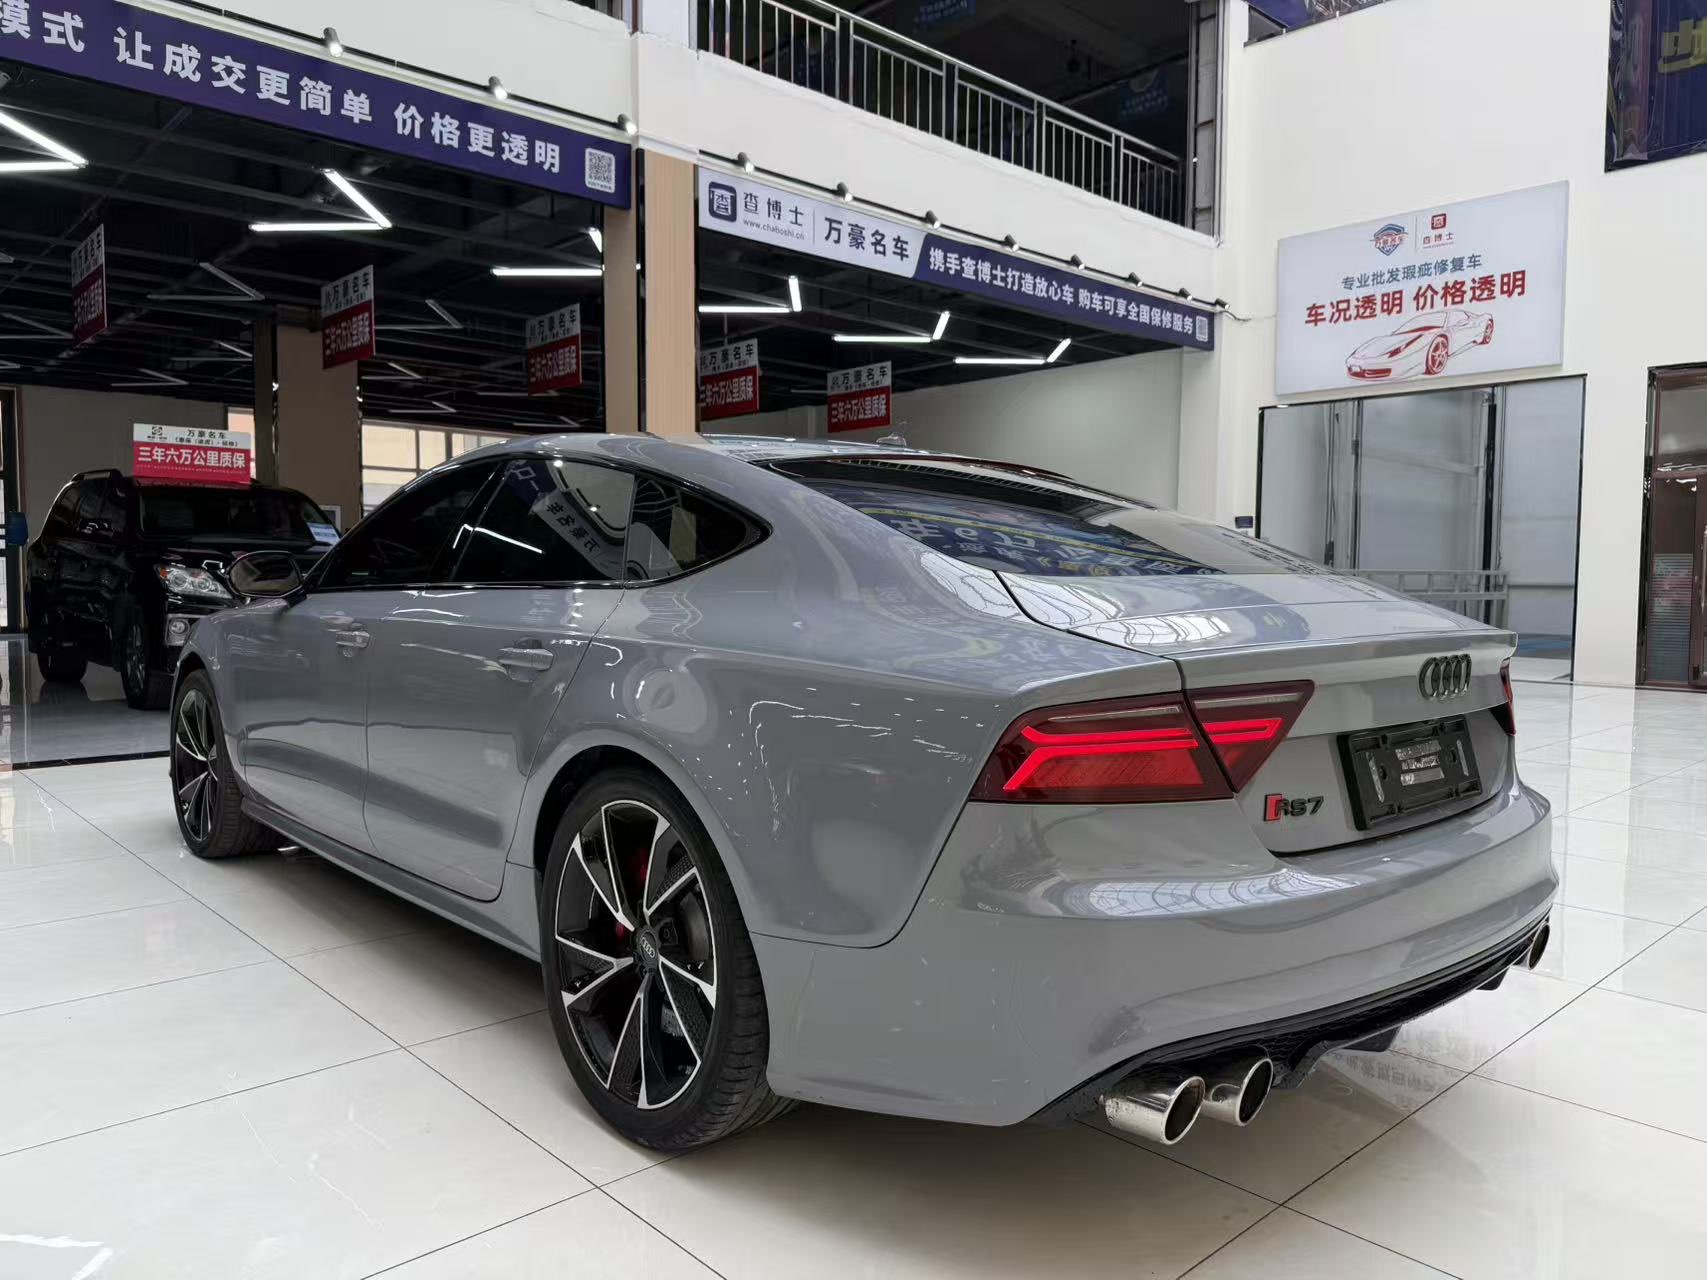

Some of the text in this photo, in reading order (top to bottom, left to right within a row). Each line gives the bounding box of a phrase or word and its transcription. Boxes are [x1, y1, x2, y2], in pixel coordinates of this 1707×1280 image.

[0, 0, 560, 174] 模式 让成交更简单 价格更透明
[744, 192, 804, 227] 查博士
[743, 219, 805, 241] www.chaboshi.cn
[824, 216, 910, 262] 万豪名车
[1341, 253, 1482, 291] 专业批发瑕疵修复车
[929, 247, 1193, 334] 携手查博士打造放心车 购车可享全国保修服务
[1304, 270, 1526, 328] 车况透明 价格透明
[831, 394, 887, 424] 三年六万公里质保
[138, 446, 246, 469] 三年六万公里质保
[1264, 794, 1325, 821] RS7
